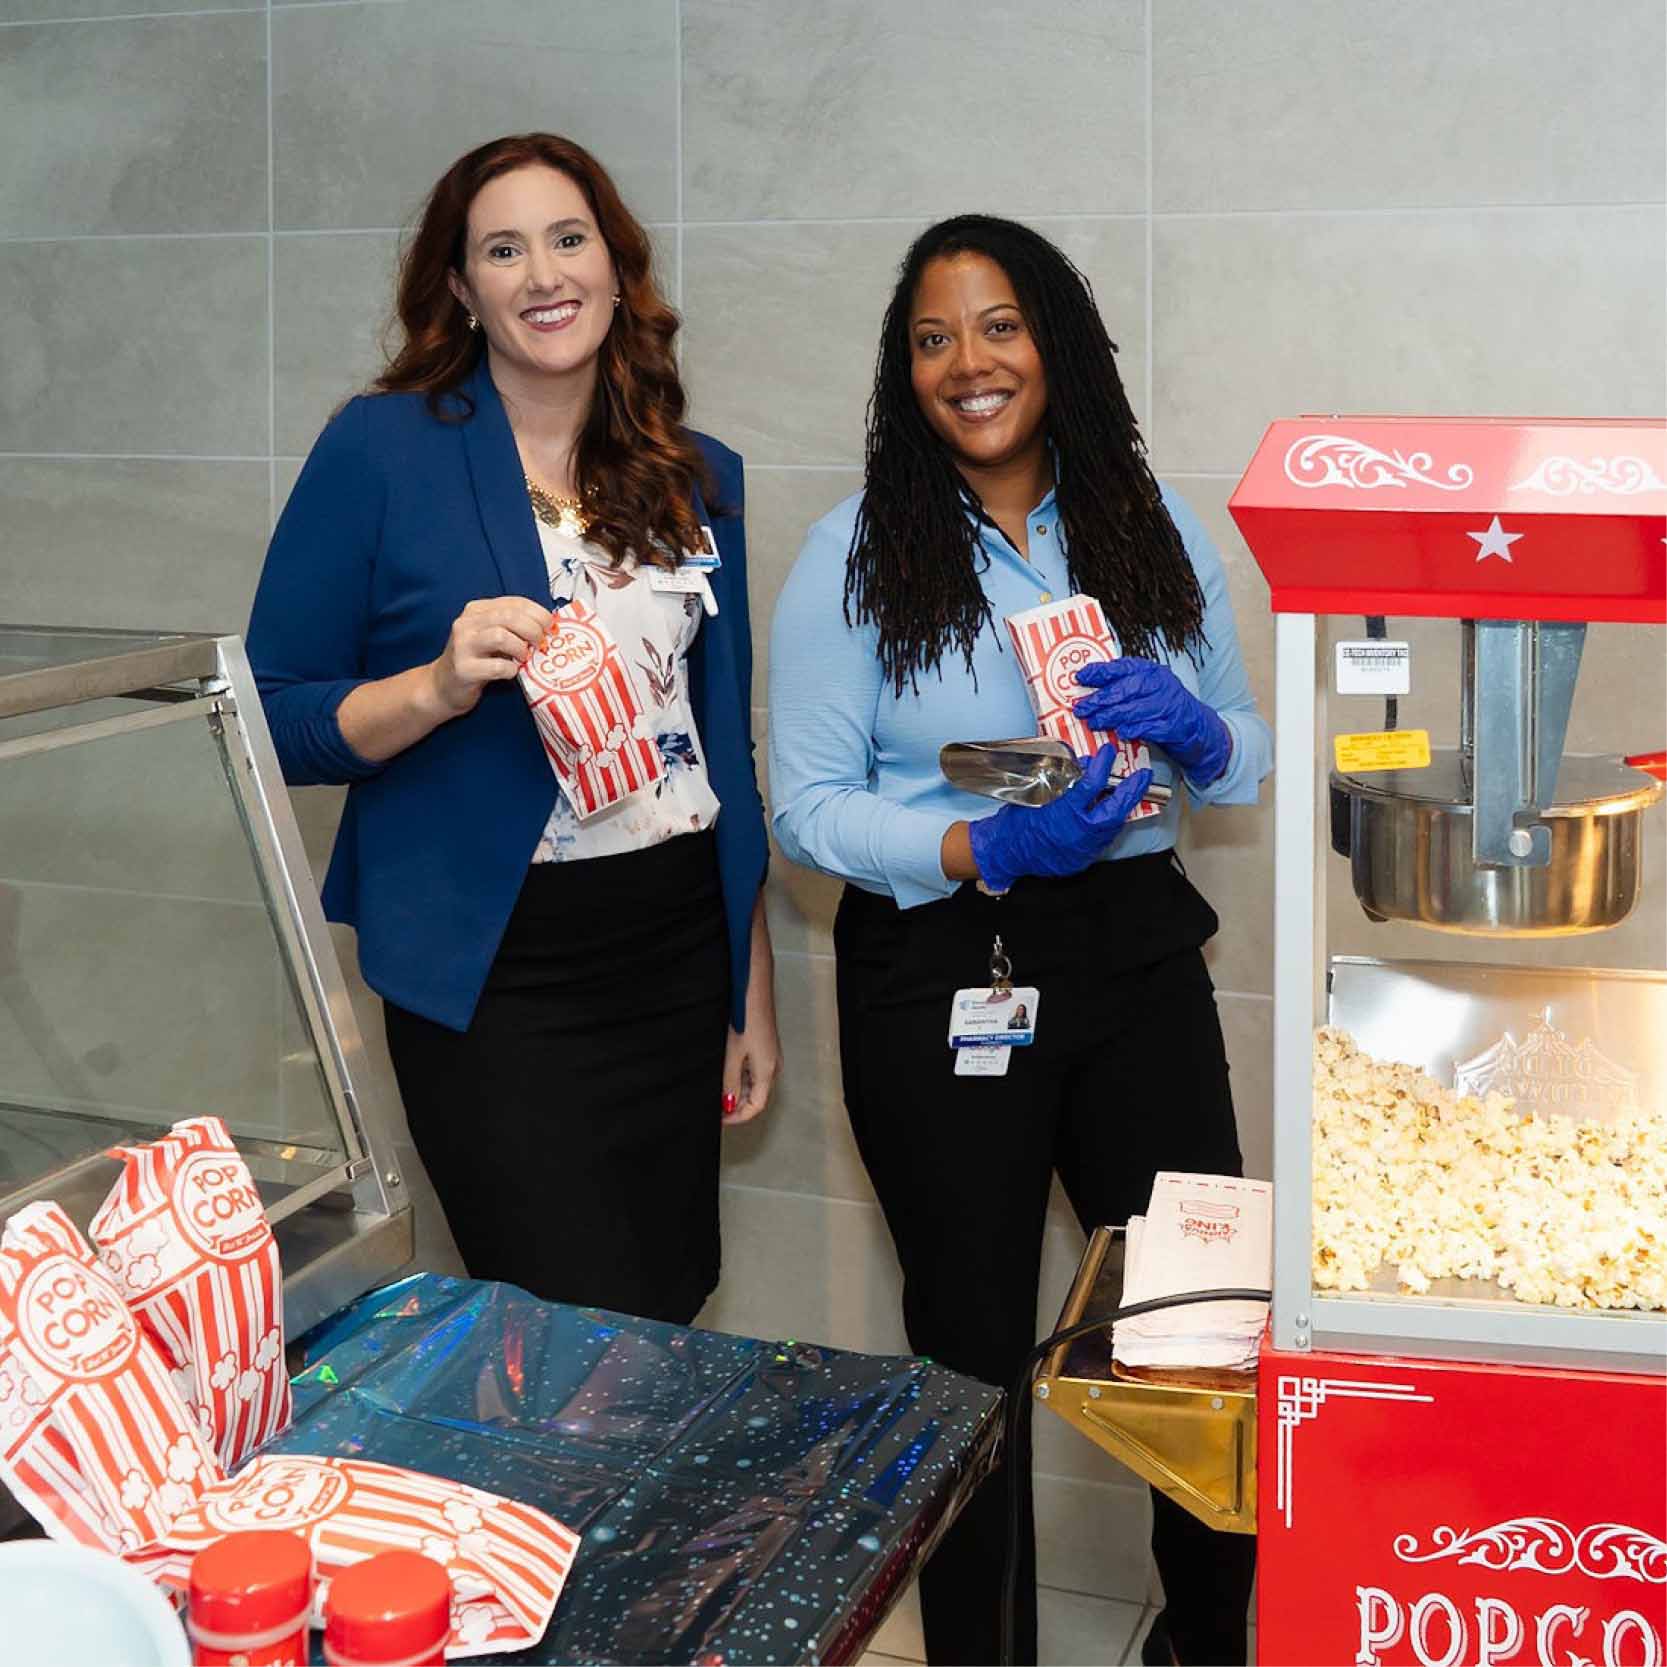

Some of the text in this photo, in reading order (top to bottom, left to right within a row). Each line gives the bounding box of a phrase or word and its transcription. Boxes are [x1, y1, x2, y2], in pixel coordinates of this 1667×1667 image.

[540, 640, 593, 673] CORN
[1060, 649, 1091, 669] POP
[1057, 670, 1081, 690] CO
[191, 1163, 239, 1195] POP
[192, 1184, 264, 1228] CORN
[36, 1272, 88, 1316] POP
[43, 1297, 117, 1351] CORN
